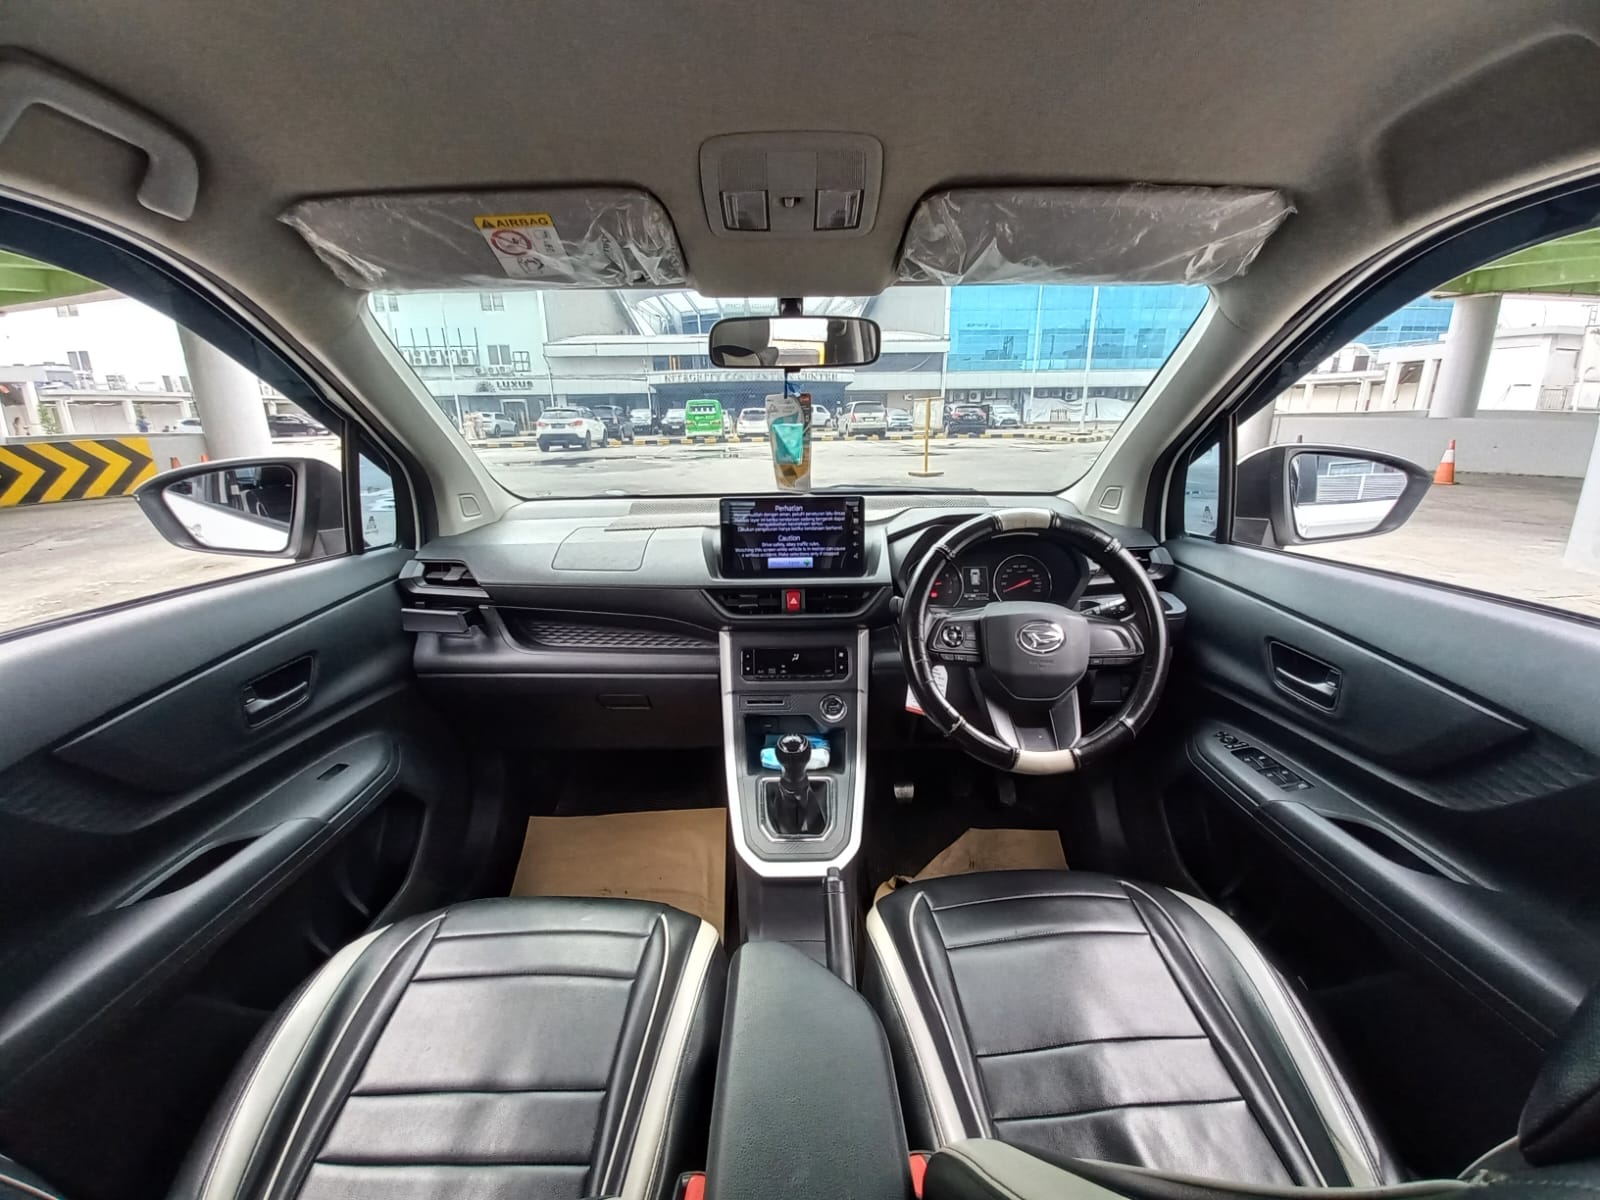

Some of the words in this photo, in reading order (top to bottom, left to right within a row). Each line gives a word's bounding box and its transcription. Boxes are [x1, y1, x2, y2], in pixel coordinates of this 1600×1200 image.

[496, 217, 549, 228] AIRBAG
[496, 380, 534, 388] LUXUS
[777, 534, 801, 542] Caution
